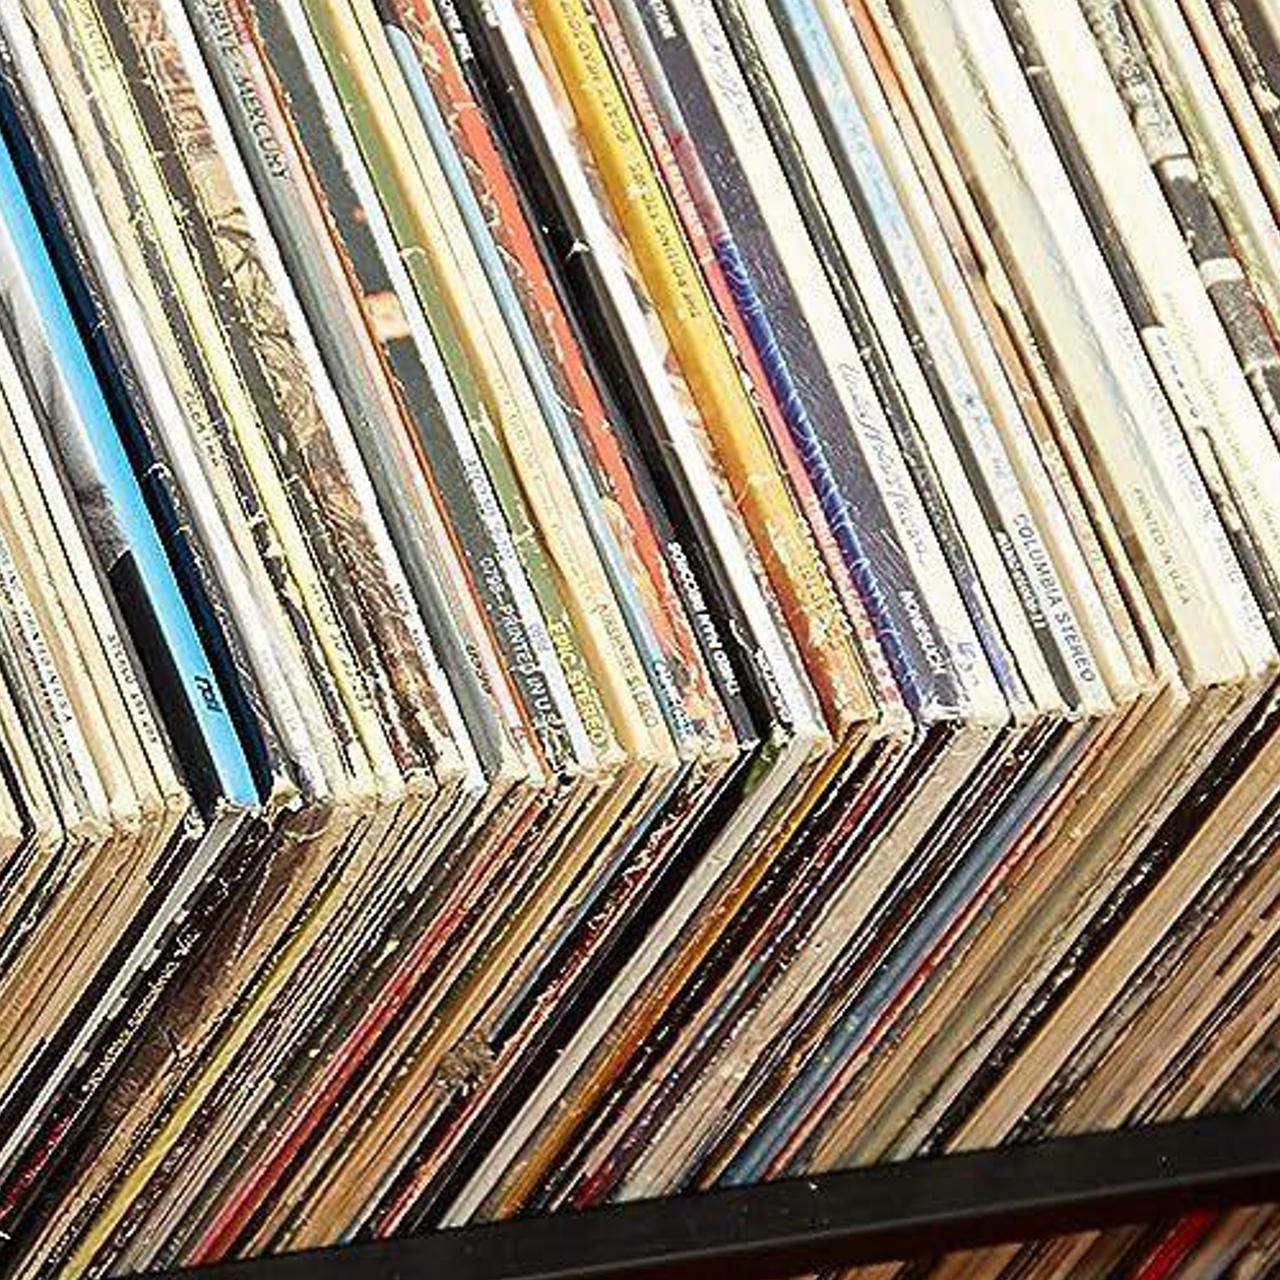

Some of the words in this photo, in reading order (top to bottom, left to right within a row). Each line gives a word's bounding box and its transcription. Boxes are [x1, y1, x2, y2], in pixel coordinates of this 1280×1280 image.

[664, 541, 707, 611] RECORDS
[1008, 513, 1067, 608] COLUMBIA
[1051, 611, 1099, 683] STEREO
[694, 613, 722, 648] MAN
[562, 670, 613, 745] STEREO
[709, 650, 742, 695] THIRD
